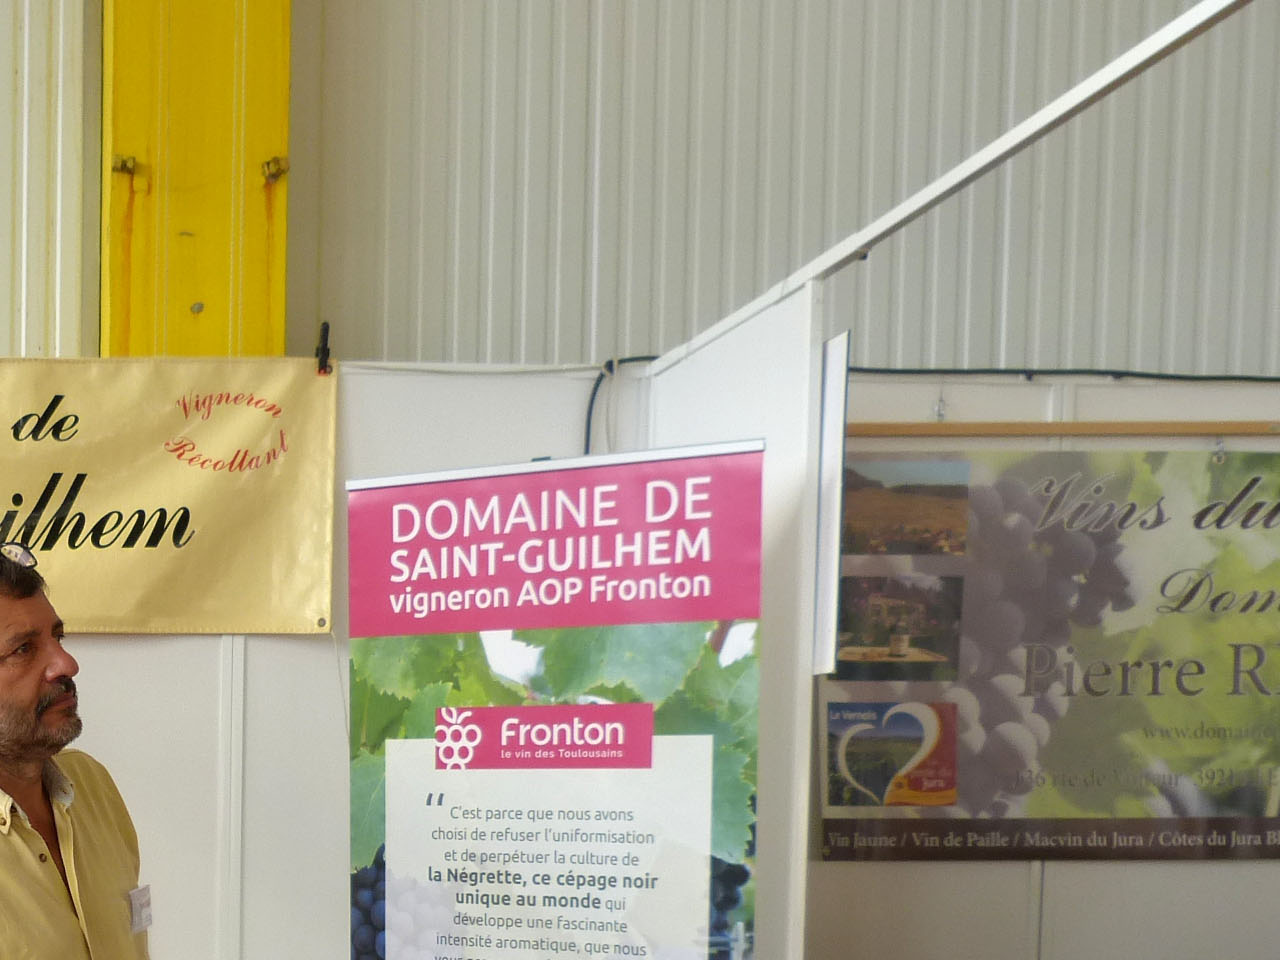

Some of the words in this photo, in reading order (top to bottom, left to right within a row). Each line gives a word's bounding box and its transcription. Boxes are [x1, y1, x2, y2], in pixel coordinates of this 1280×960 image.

[175, 391, 284, 420] Vigneron
[10, 395, 80, 442] de
[392, 484, 619, 543] DOMAINE
[645, 476, 712, 524] DE
[1028, 471, 1172, 531] Vins
[1193, 475, 1280, 531] du
[389, 527, 712, 583] SAINT-GUILHEM
[389, 586, 510, 618] vigneron
[516, 576, 583, 606] AOP
[589, 572, 711, 603] Fronton
[1018, 644, 1206, 697] Pierre
[1227, 643, 1280, 697] R
[501, 717, 624, 746] Fronton
[501, 749, 512, 759] le
[515, 749, 531, 759] vin
[535, 749, 555, 759] des
[559, 749, 623, 759] Toulousains
[485, 809, 523, 823] parce
[527, 809, 554, 824] que
[557, 810, 591, 821] nous
[594, 811, 634, 822] avons
[431, 827, 467, 841] choisi
[471, 827, 487, 841] de
[491, 828, 541, 842] refuser
[828, 832, 851, 847] Vin
[912, 832, 939, 847] Vin
[943, 831, 963, 847] de
[967, 831, 1009, 847] Paille
[1024, 831, 1084, 847] Macvin
[1087, 831, 1107, 847] du
[1112, 831, 1144, 849] Jura
[1158, 830, 1204, 848] Côtes
[1207, 830, 1227, 847] du
[1231, 830, 1262, 849] Jura
[444, 850, 457, 862] et
[460, 849, 477, 862] de
[480, 850, 550, 866] perpétuer
[554, 850, 566, 864] la
[569, 851, 618, 866] culture
[622, 852, 639, 866] de
[428, 867, 442, 882] la
[447, 868, 527, 887] Négrette,
[532, 873, 551, 886] ce
[556, 871, 617, 891] cépage
[623, 873, 658, 889] noir
[456, 890, 511, 909] unique
[516, 894, 536, 906] au
[542, 893, 601, 909] monde
[605, 897, 626, 911] qui
[453, 913, 522, 930] développe
[527, 917, 553, 929] une
[557, 916, 627, 932] fascinante
[436, 933, 492, 948] intensité
[496, 936, 580, 954] aromatique,
[584, 941, 610, 956] que
[614, 943, 647, 956] nous
